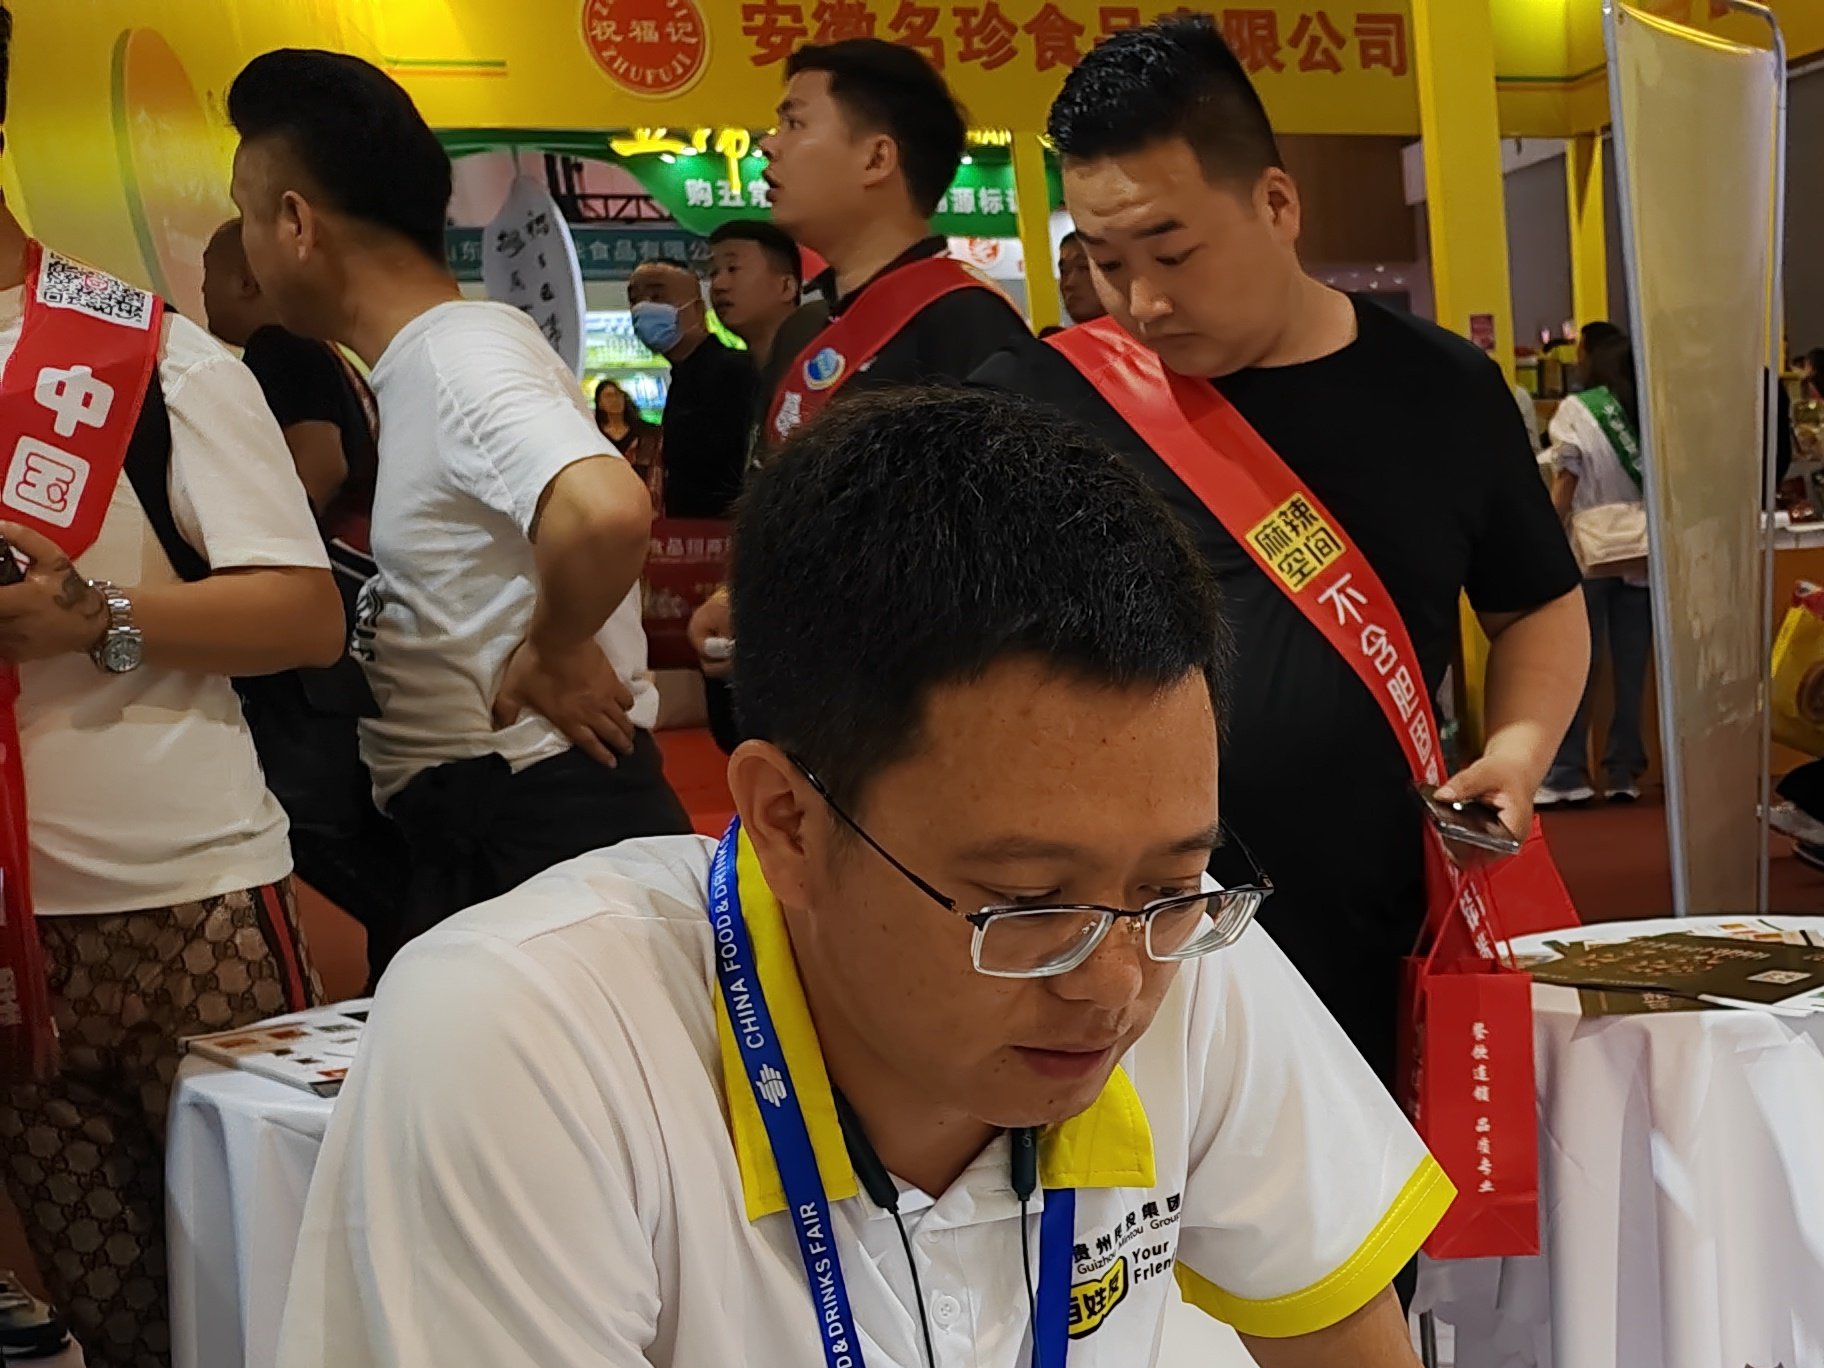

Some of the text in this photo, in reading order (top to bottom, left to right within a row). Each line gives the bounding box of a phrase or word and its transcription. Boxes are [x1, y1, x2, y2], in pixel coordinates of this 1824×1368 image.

[591, 19, 698, 44] 祝福记
[742, 2, 1407, 77] 安徽名珍食限公司
[729, 977, 765, 1049] CHINA
[799, 1201, 828, 1256] FAIR
[1132, 1241, 1169, 1264] Your
[1134, 1252, 1175, 1285] Frien
